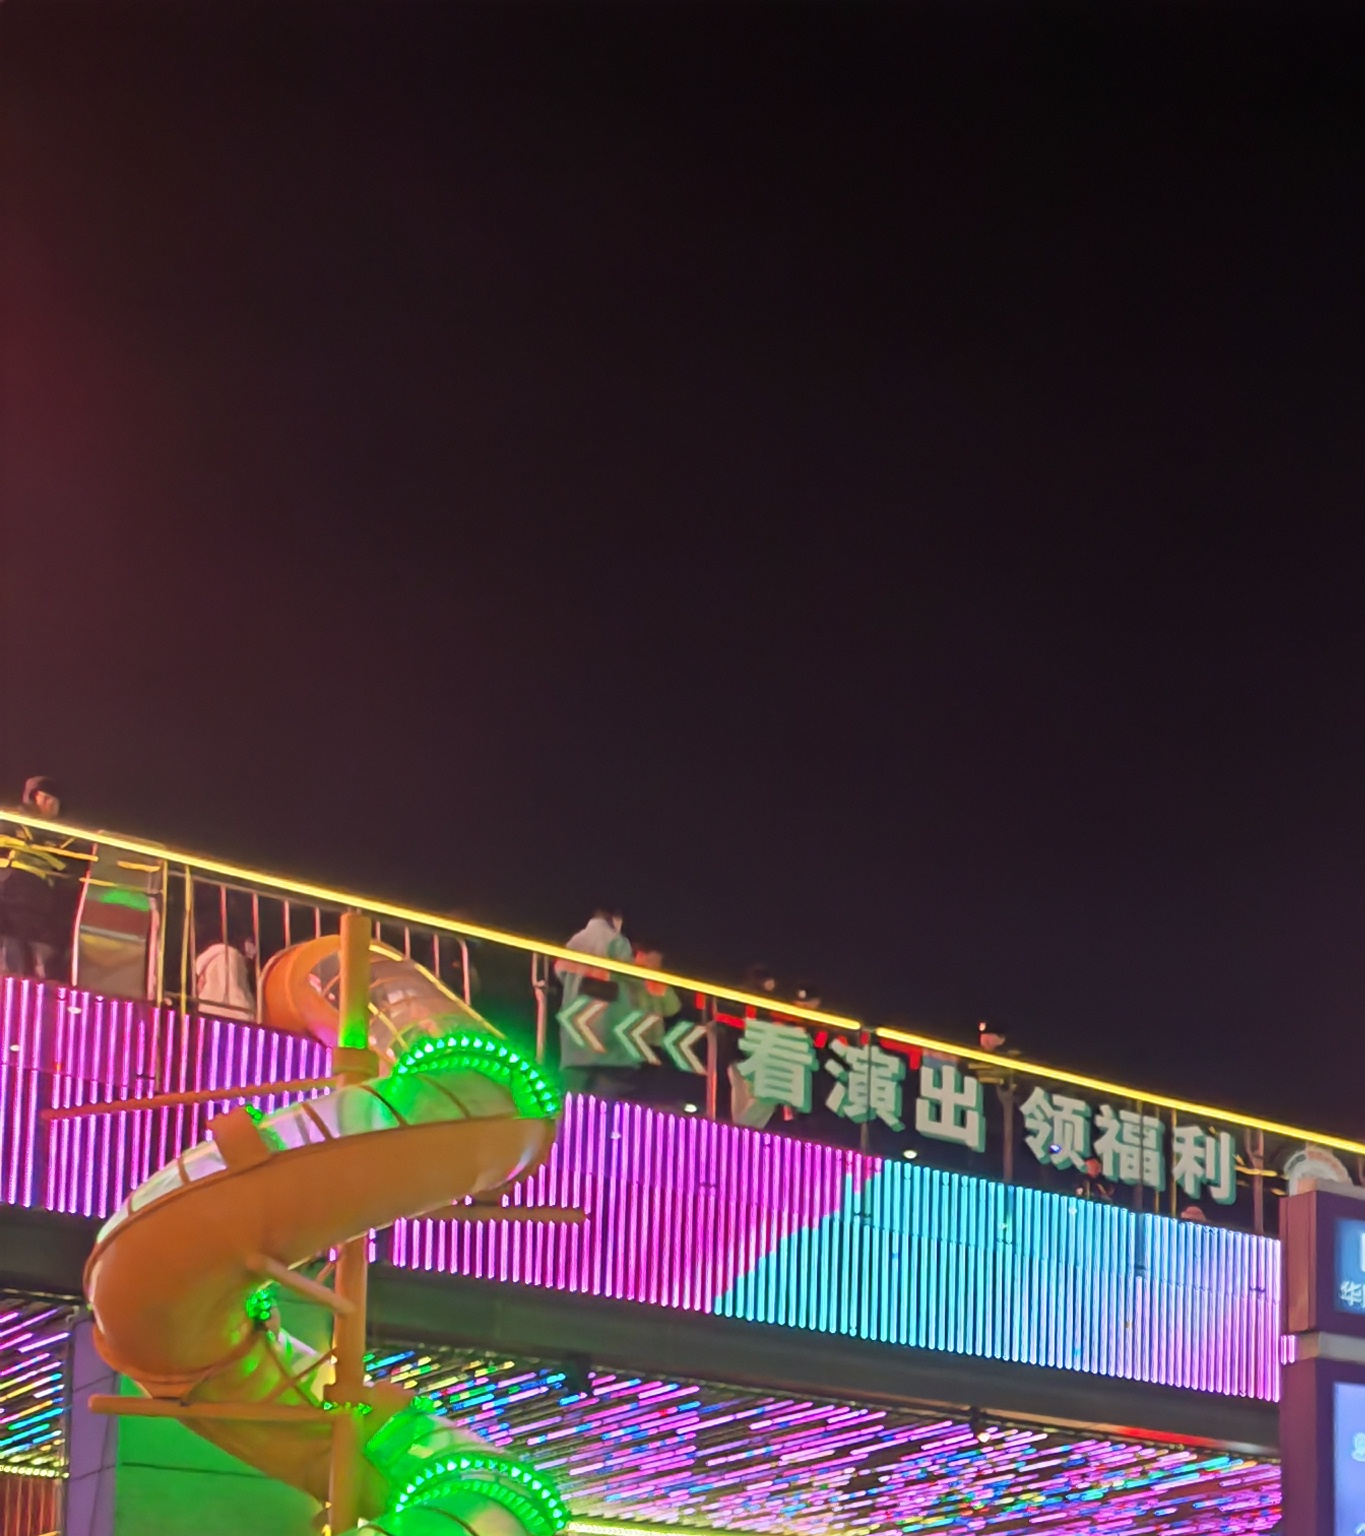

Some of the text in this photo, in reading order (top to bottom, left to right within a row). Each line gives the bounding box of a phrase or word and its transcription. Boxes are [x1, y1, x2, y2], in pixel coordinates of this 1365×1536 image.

[737, 1018, 1237, 1204] 看演出 领福利
